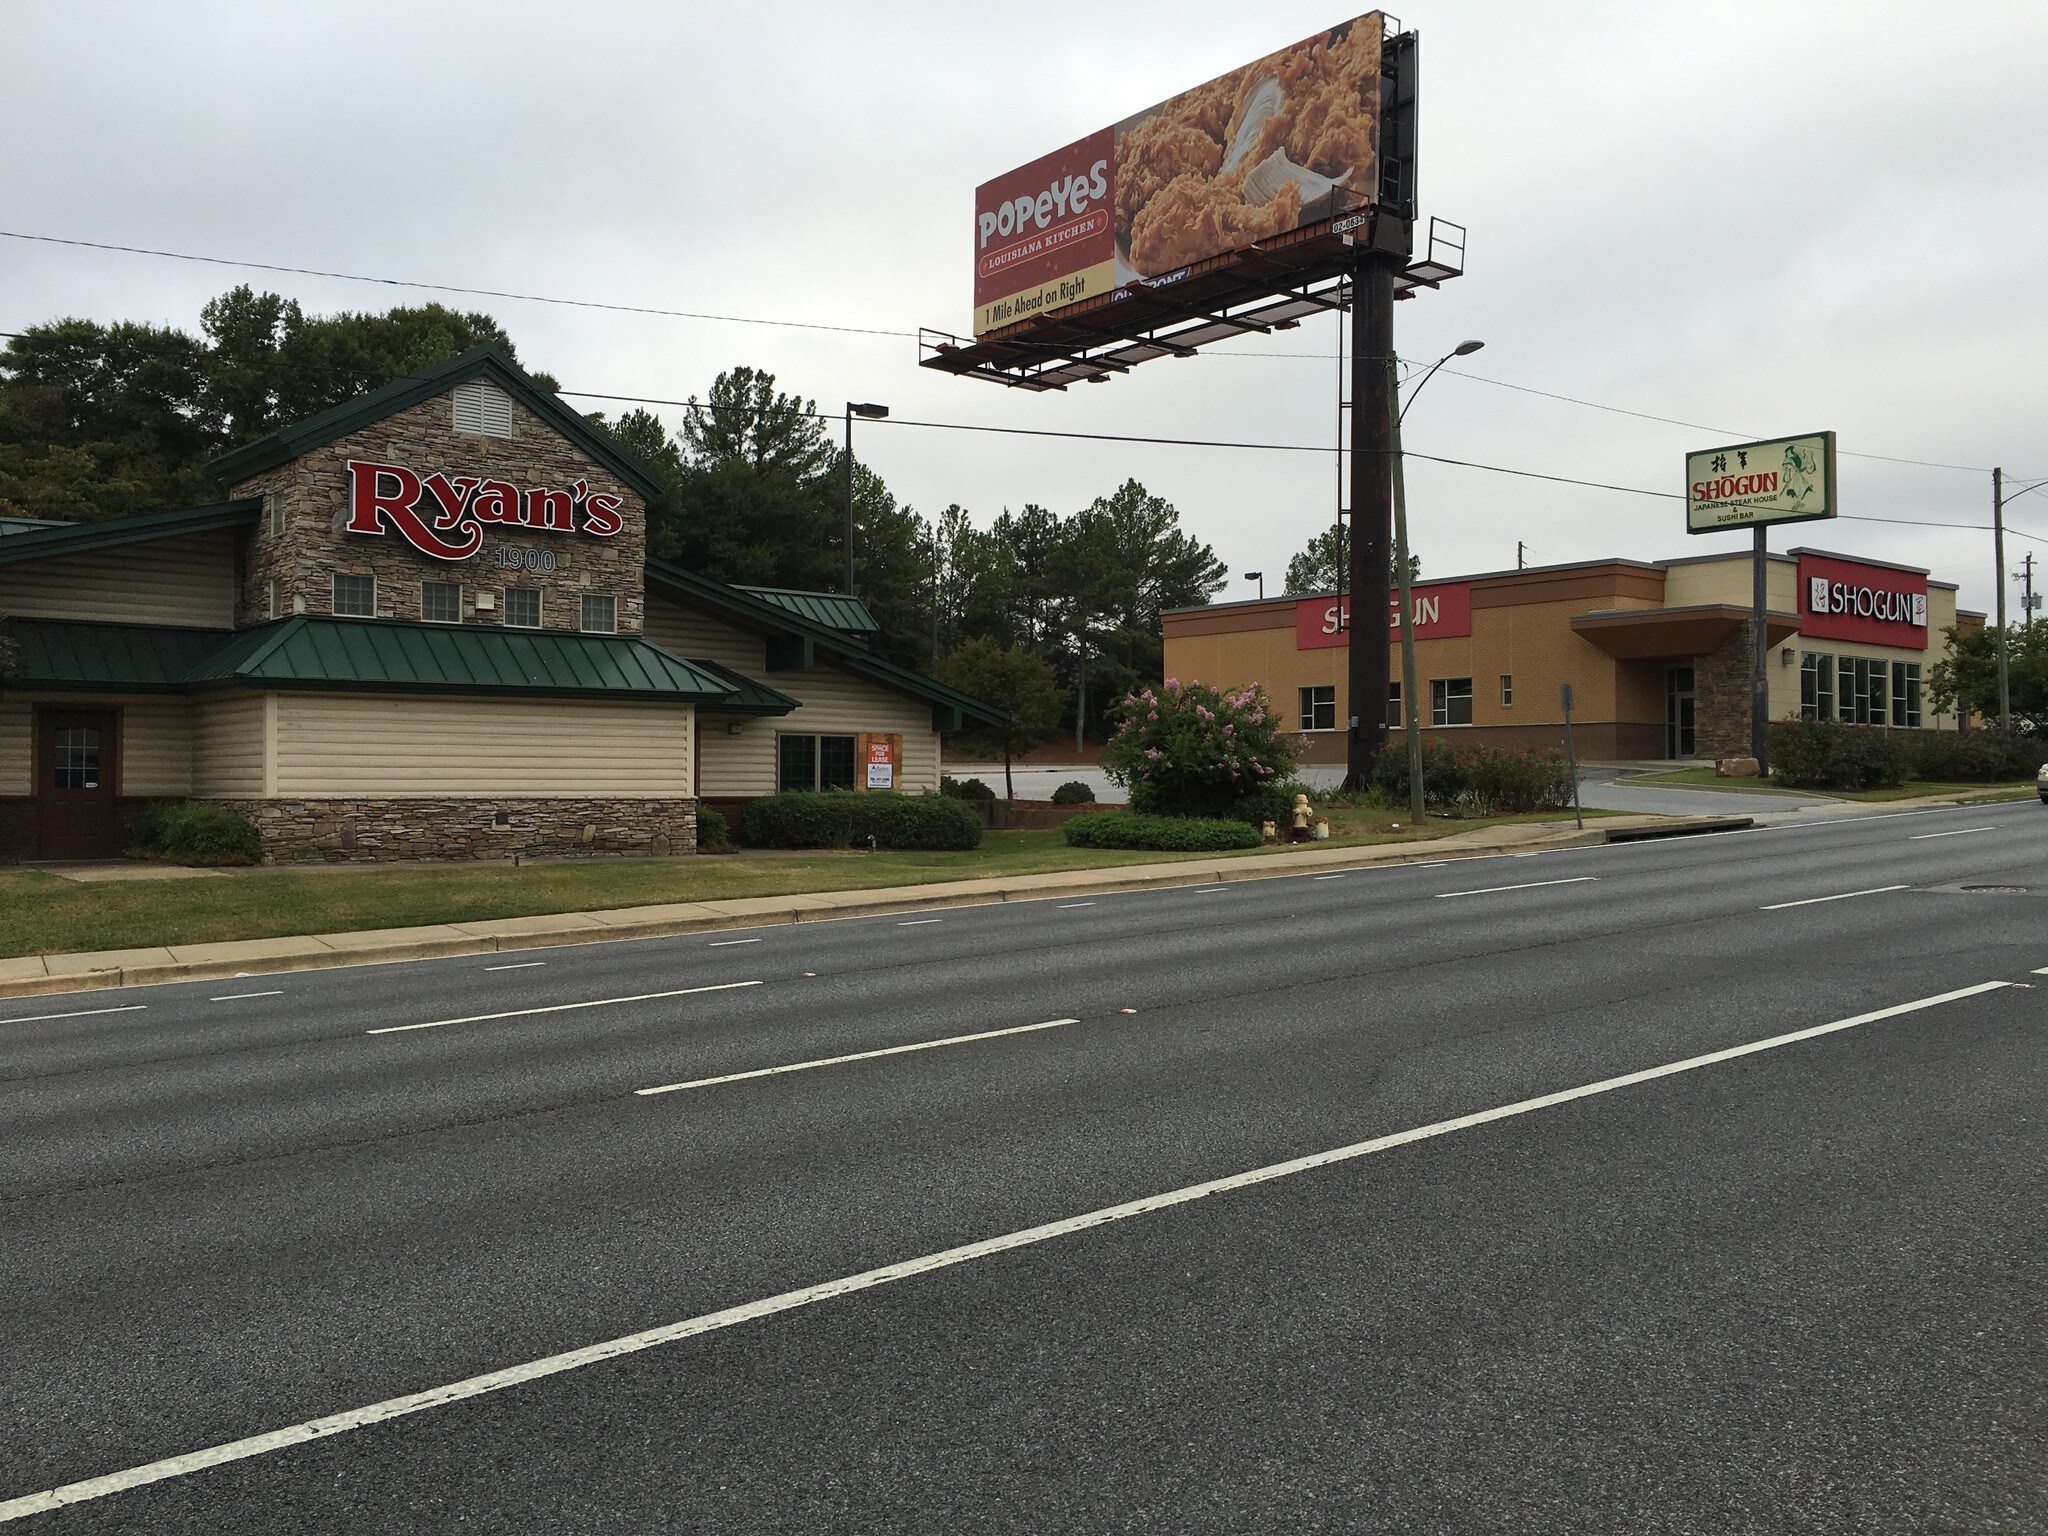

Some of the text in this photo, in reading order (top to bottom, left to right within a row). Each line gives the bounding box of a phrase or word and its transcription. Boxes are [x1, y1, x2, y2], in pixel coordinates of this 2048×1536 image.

[988, 219, 1095, 269] LOUISIANA KITCHEN
[985, 276, 1086, 325] 1 Mile Ahead on Right
[346, 459, 624, 560] Ryan's
[1694, 494, 1778, 511] JAPANESE STEAK HOUSE
[1717, 511, 1754, 522] SUSHI BAR
[495, 546, 556, 573] 1900
[1321, 595, 1440, 635] SHGUN
[1831, 582, 1910, 622] SHOGUN
[871, 744, 889, 752] SPACE
